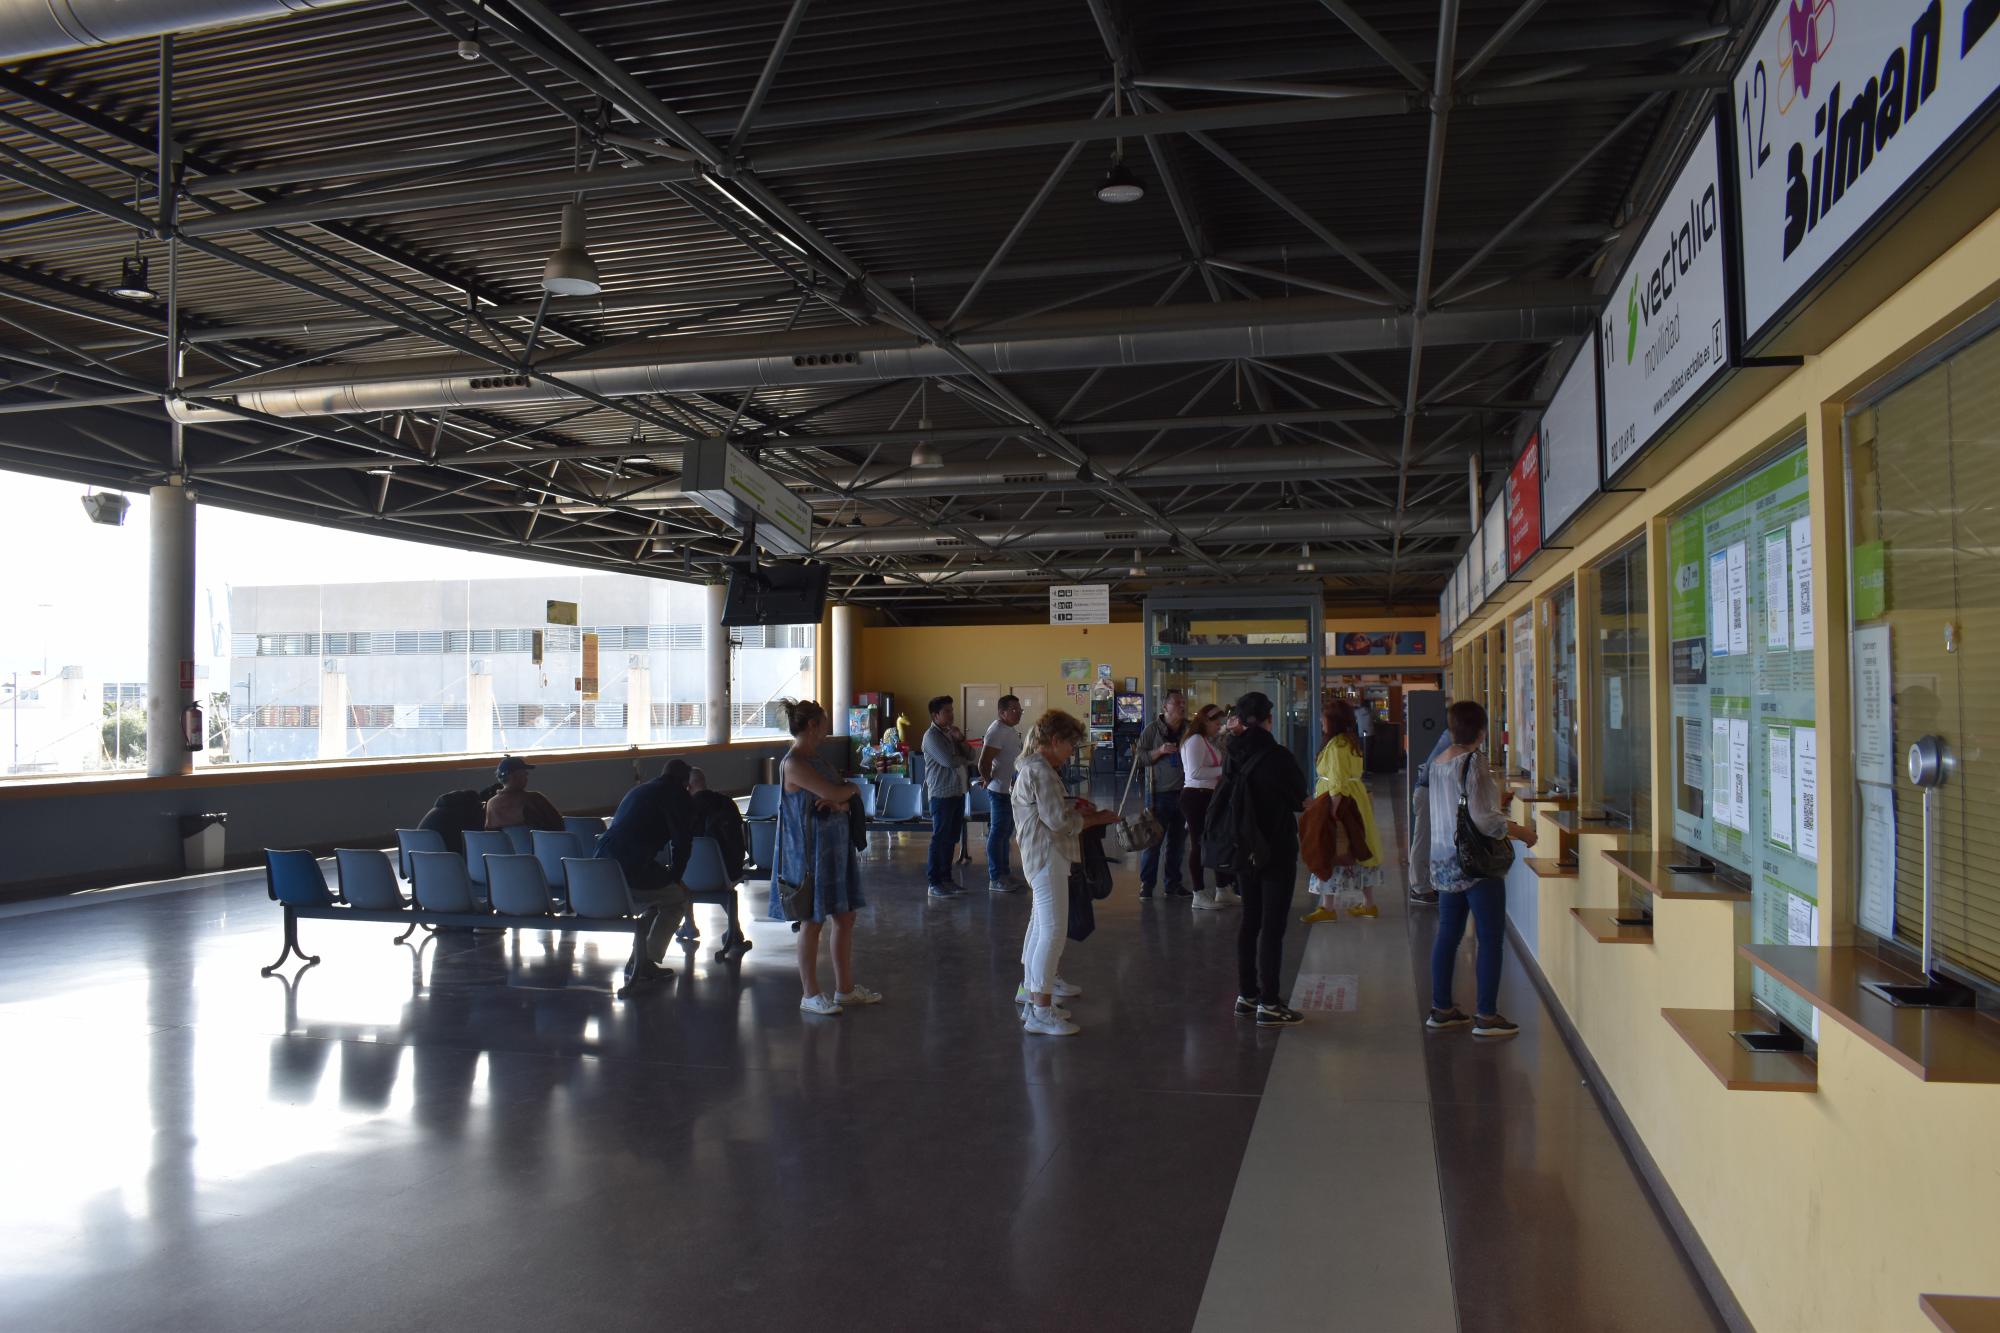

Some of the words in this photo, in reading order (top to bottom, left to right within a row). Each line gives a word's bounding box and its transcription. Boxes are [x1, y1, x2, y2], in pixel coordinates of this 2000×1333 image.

[1742, 59, 1771, 180] 12
[1783, 0, 1942, 262] Bilman
[1640, 182, 1718, 327] vectalia
[1604, 314, 1615, 369] 11
[1644, 302, 1680, 380] movilidad
[1653, 346, 1710, 416] www.movilidad.vectalia.es
[1542, 428, 1550, 483] 10
